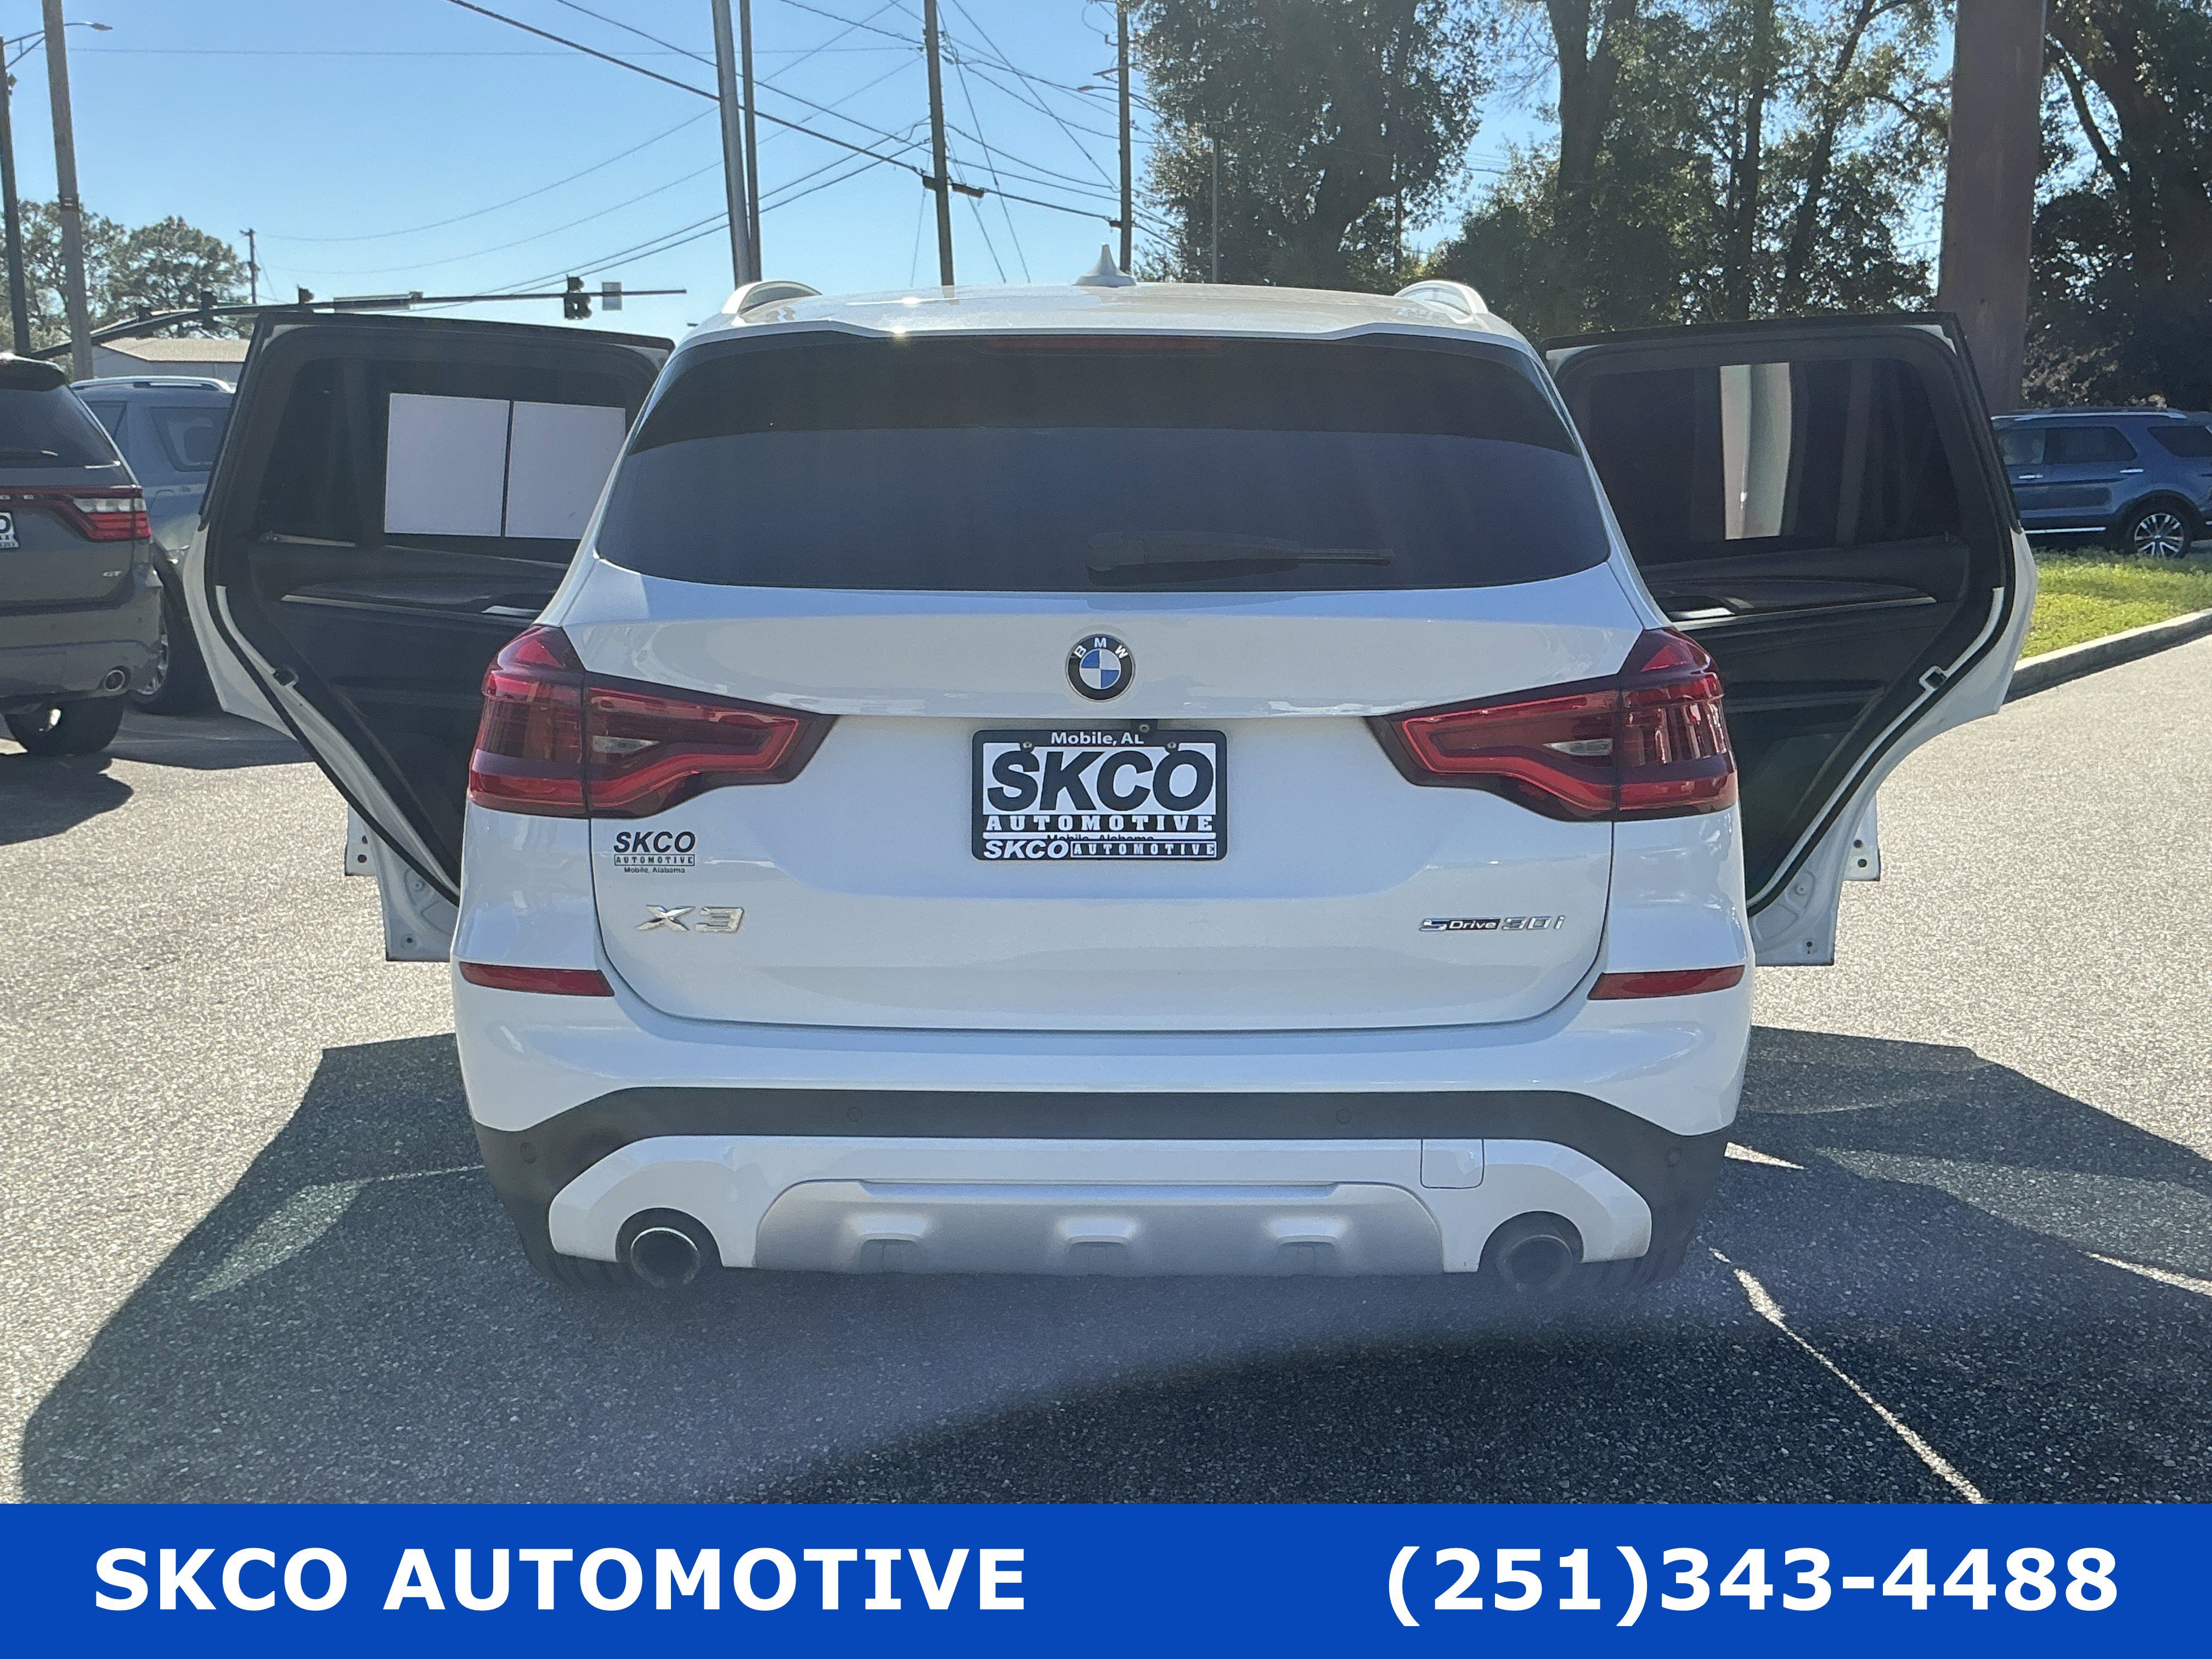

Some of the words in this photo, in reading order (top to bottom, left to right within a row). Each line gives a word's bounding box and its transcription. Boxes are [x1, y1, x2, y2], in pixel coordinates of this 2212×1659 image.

[1074, 637, 1128, 659] BMW
[1050, 732, 1118, 746] Mobile,
[1120, 732, 1144, 745] AL
[987, 750, 1215, 812] SKCO
[986, 815, 1214, 832] AUTOMOTIVE
[613, 831, 696, 853] SKCO
[983, 840, 1069, 859] SKCO
[1073, 844, 1215, 855] AUTOMOTIVE
[616, 856, 693, 864] AUTOMOTIVE
[634, 905, 745, 933] X3
